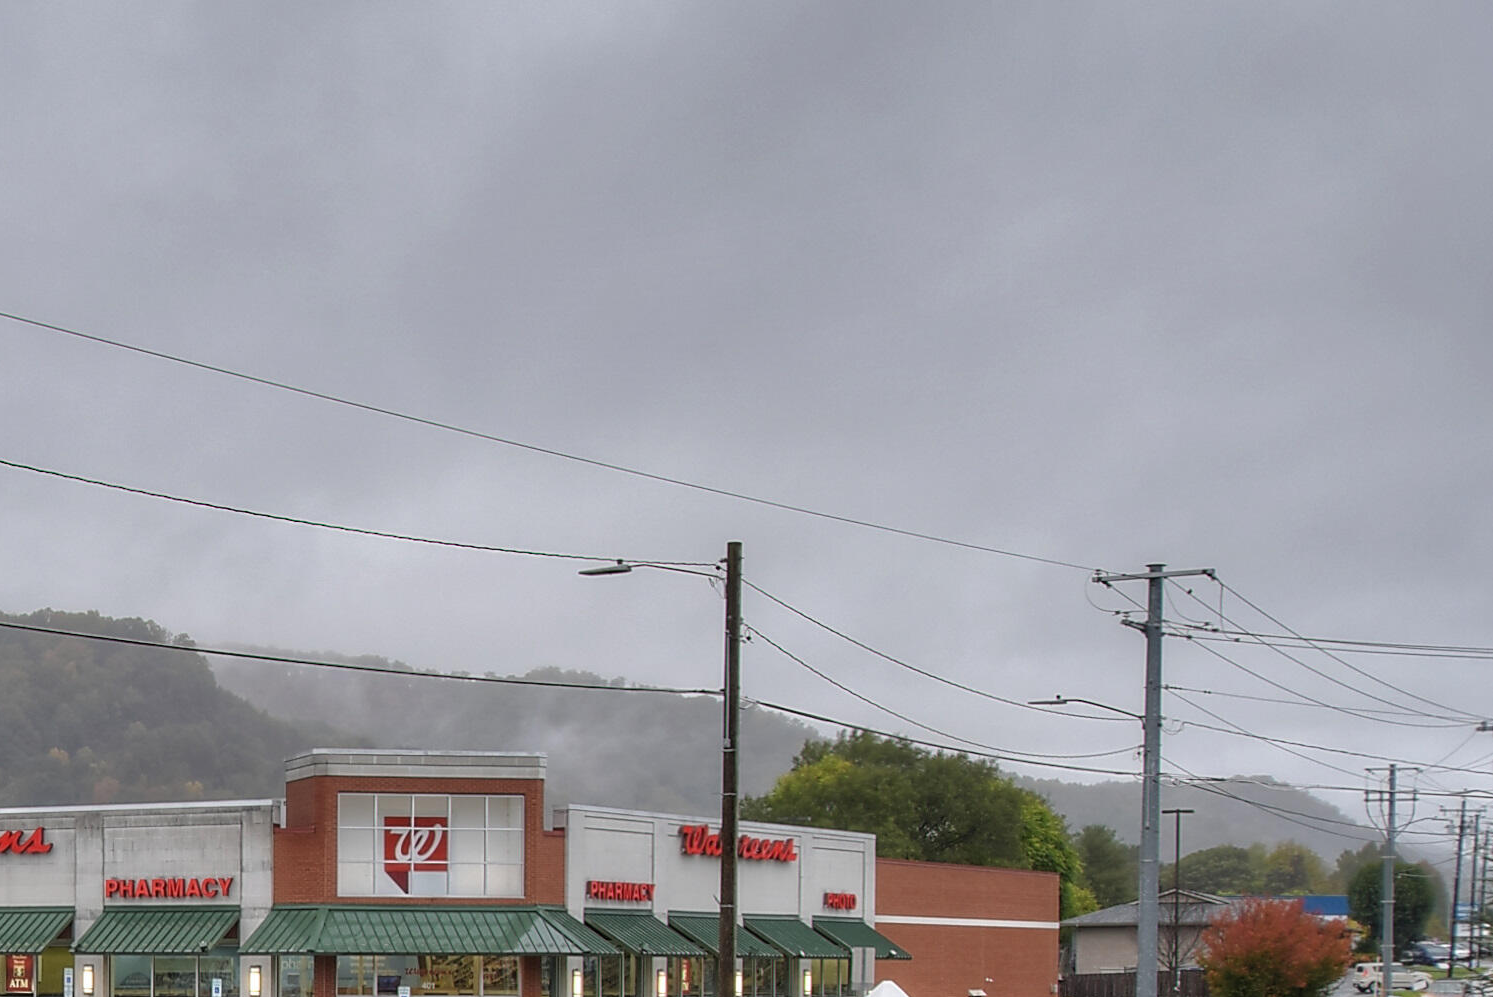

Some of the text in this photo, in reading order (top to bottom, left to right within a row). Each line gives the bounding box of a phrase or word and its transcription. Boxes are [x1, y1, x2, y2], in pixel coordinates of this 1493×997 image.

[680, 825, 797, 861] Wareens
[105, 877, 233, 898] PHARMACY
[587, 881, 655, 901] PHARMACY
[9, 978, 28, 988] ATM
